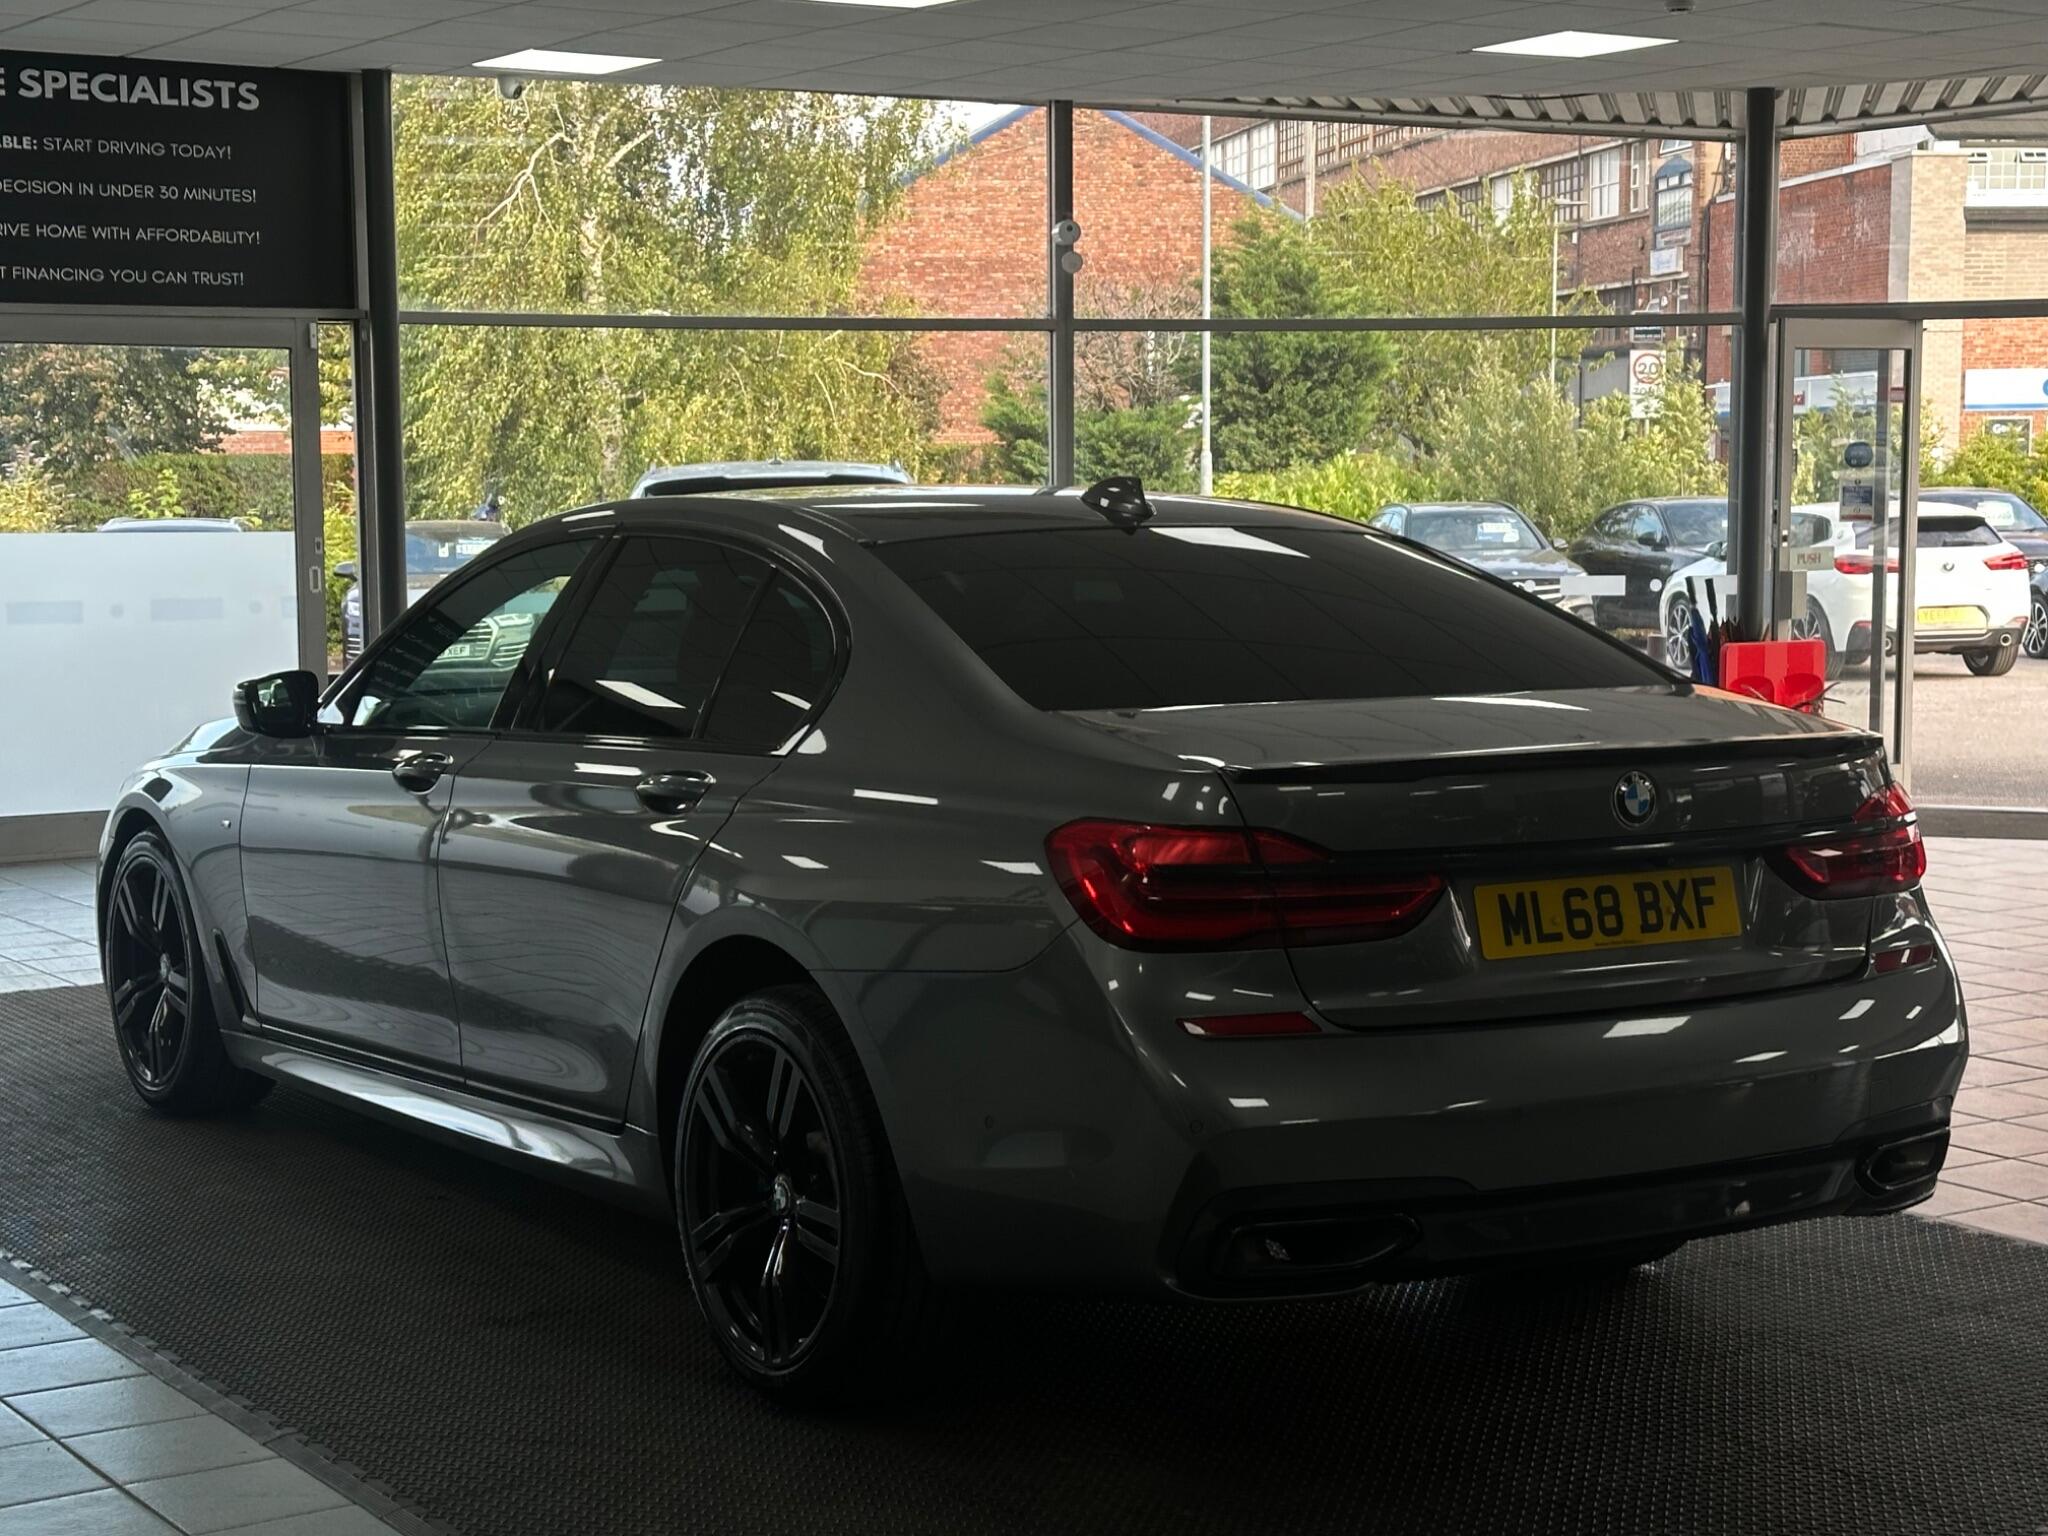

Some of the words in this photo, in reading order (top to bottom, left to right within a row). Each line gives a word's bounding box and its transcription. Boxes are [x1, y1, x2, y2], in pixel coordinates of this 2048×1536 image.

[18, 68, 260, 111] SPECIALISTS
[0, 135, 37, 150] BLE:
[43, 137, 92, 152] START
[98, 139, 165, 156] DRIVING
[171, 143, 231, 159] TODAY!
[0, 179, 73, 195] ECISION
[79, 182, 93, 195] IN
[99, 183, 154, 198] UNDER
[160, 186, 179, 199] 30
[183, 187, 256, 203] MINUTES!
[36, 224, 86, 239] HOME
[92, 226, 130, 240] WITH
[136, 228, 260, 245] AFFORDABILITY!
[12, 266, 104, 282] FINANCING
[110, 269, 146, 283] YOU
[152, 271, 187, 284] CAN
[192, 271, 243, 286] TRUST!
[1638, 362, 1659, 375] 20
[1797, 552, 1821, 565] PUSH
[1498, 884, 1625, 947] ML68
[1633, 875, 1716, 935] BXF
